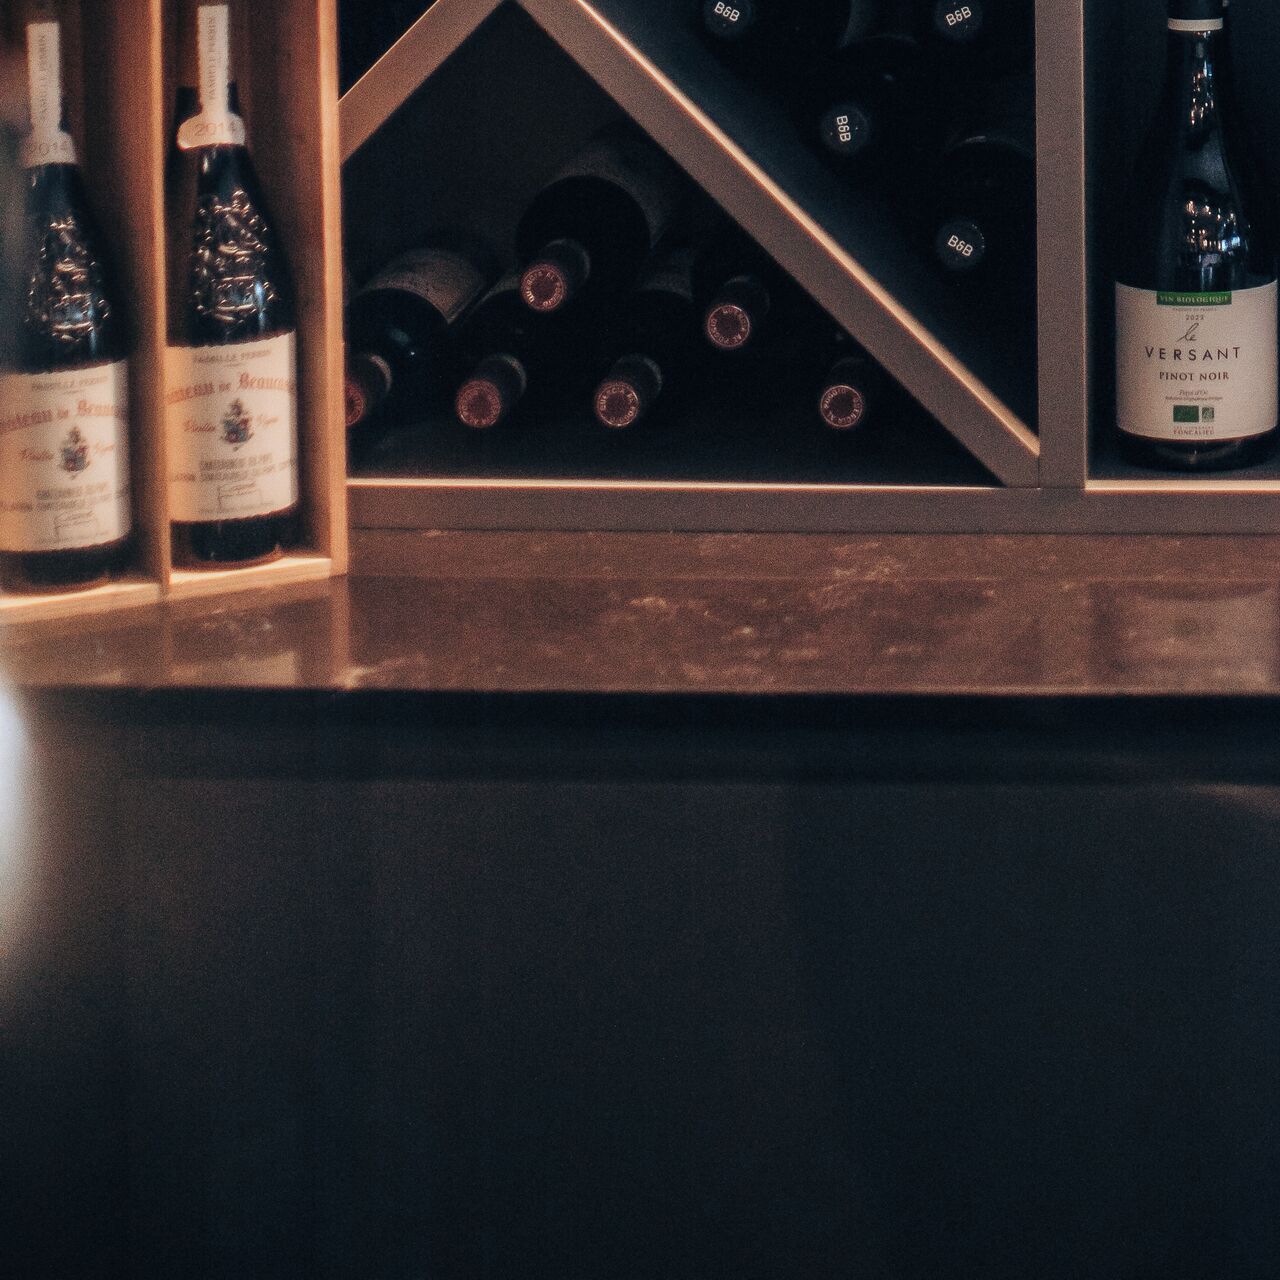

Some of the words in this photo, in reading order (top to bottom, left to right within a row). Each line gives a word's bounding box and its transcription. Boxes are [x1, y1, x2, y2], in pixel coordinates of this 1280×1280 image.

[714, 1, 740, 22] B&B
[946, 6, 973, 26] B&B
[836, 115, 852, 142] B&B
[947, 234, 974, 257] B&B
[1176, 295, 1229, 303] BIOLOGIQUE
[1176, 322, 1199, 342] le
[1144, 346, 1241, 361] VERSANT
[1159, 371, 1195, 381] PINOT
[1199, 371, 1230, 381] NOIR
